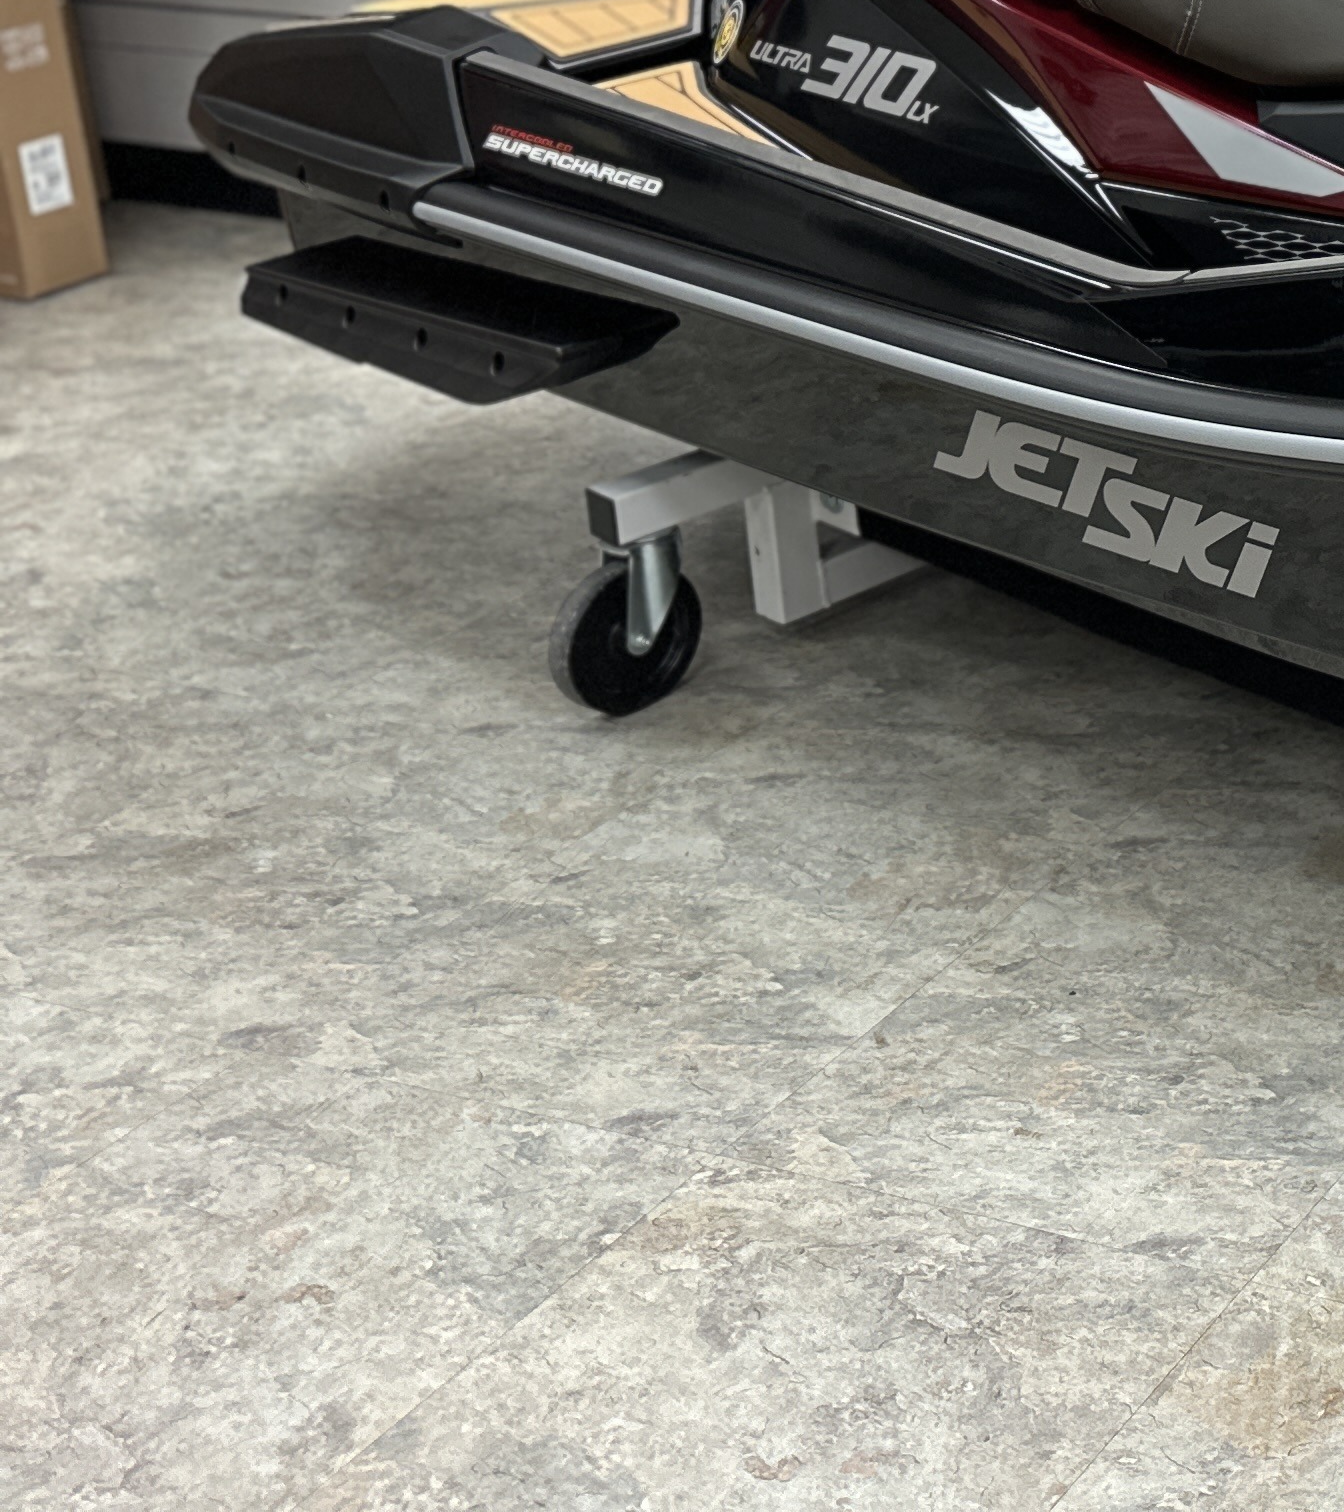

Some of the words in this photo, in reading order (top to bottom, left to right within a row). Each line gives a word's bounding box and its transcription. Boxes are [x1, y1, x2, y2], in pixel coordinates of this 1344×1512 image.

[750, 40, 812, 74] ULTRA
[801, 34, 937, 117] 310
[906, 100, 940, 124] LX
[483, 132, 664, 197] SUPERCHARGED
